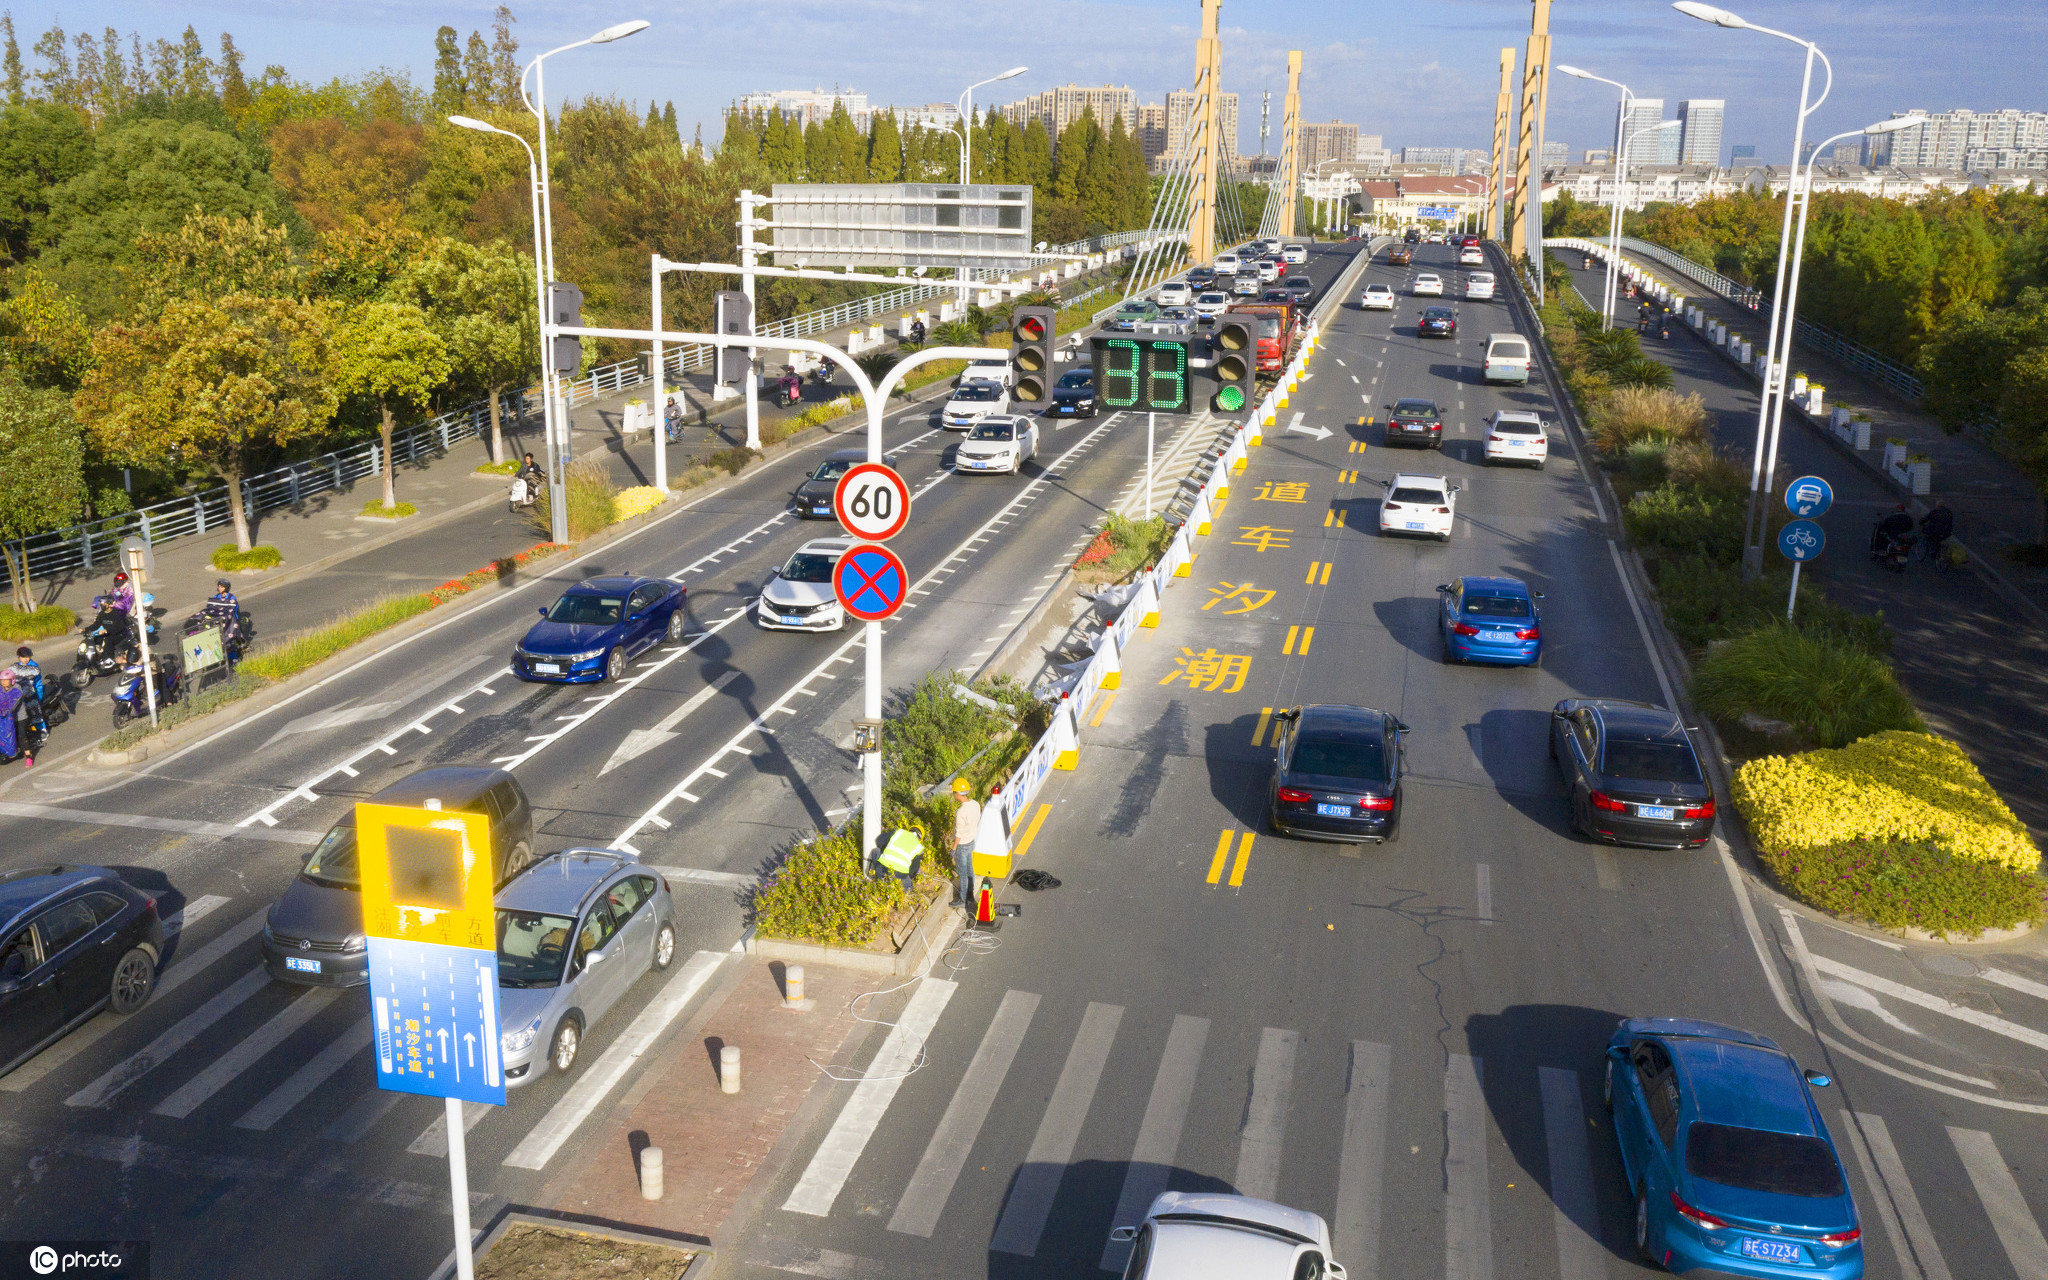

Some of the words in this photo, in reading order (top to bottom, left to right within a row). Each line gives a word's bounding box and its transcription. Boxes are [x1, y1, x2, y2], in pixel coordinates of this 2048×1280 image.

[1107, 340, 1185, 409] 33
[851, 484, 892, 520] 60
[405, 1018, 423, 1073] 潮汐车道
